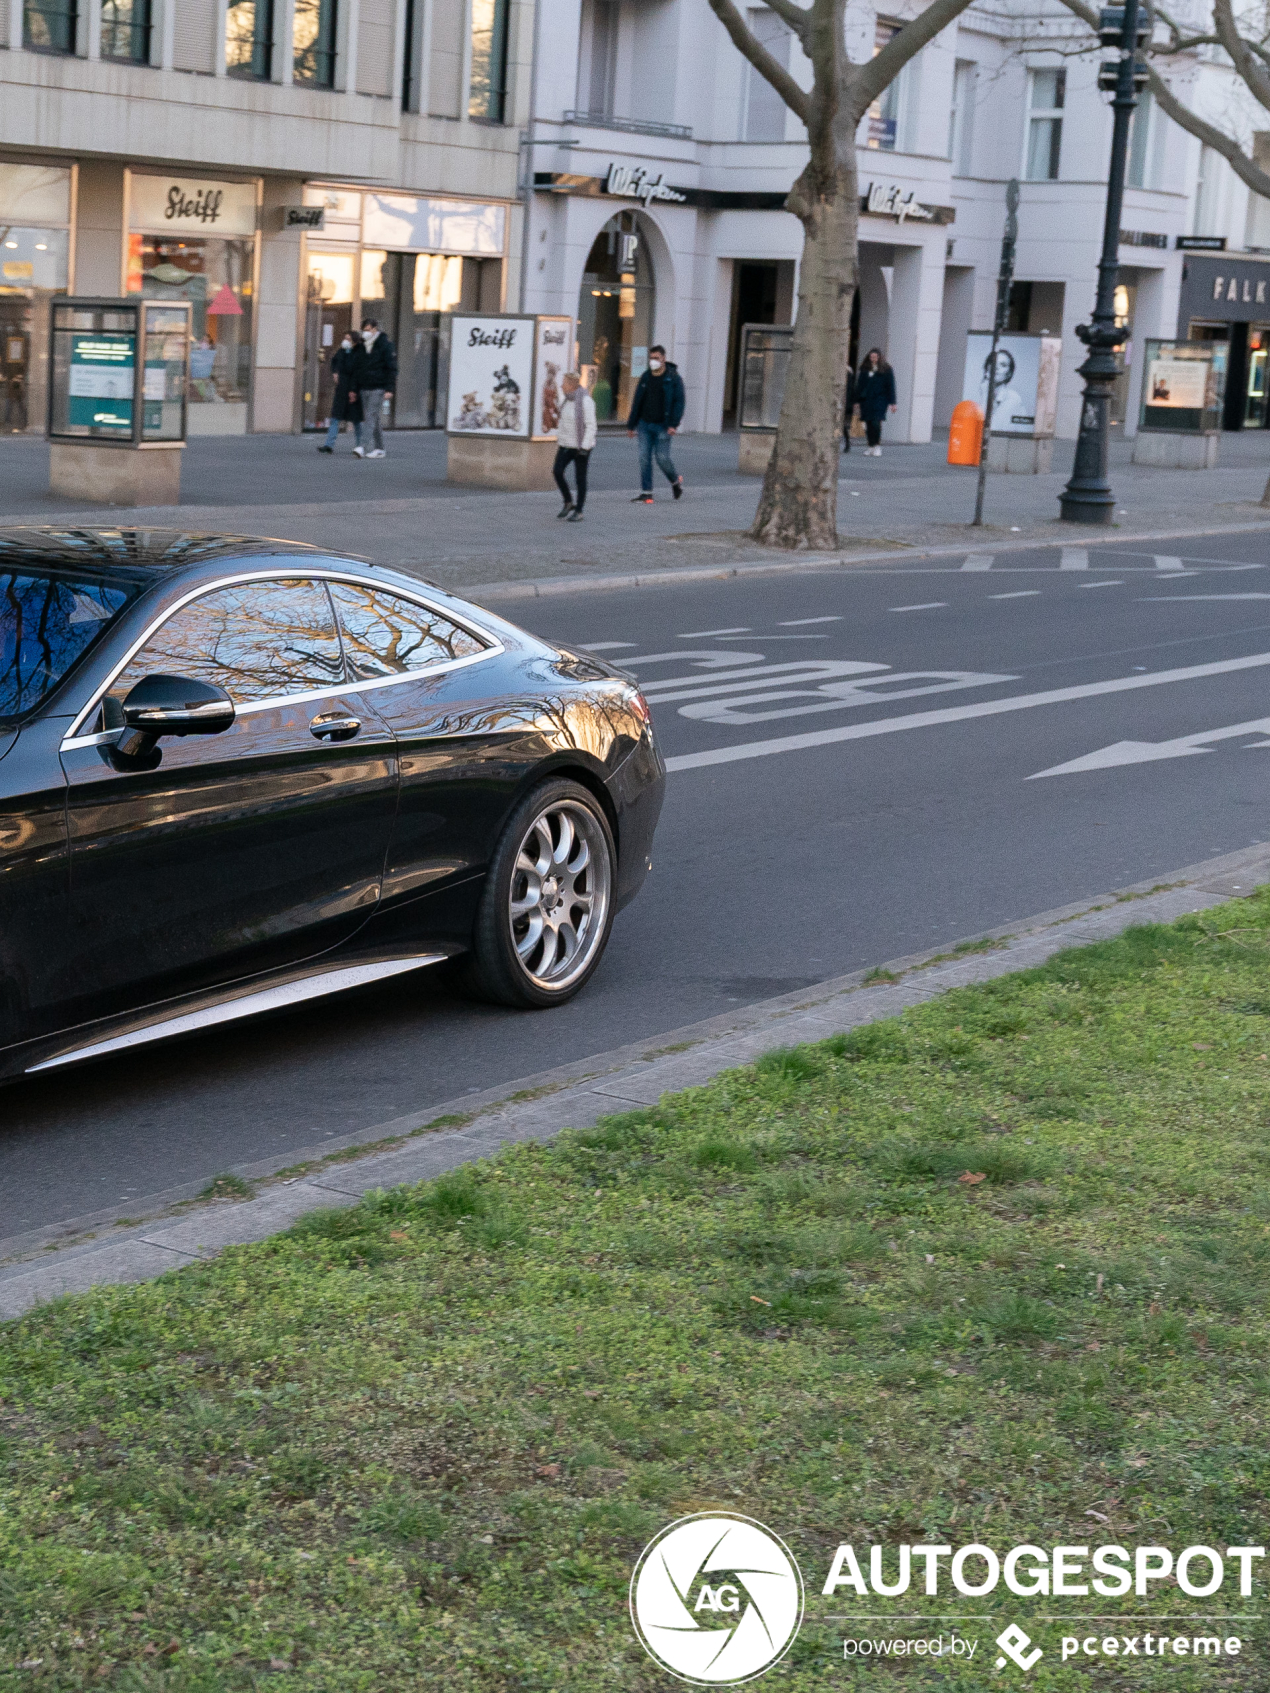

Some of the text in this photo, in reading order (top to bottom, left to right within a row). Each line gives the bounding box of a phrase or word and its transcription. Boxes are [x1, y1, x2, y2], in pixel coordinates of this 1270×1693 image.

[164, 185, 223, 224] Steiff
[1212, 275, 1267, 304] FALK
[467, 327, 517, 349] Steiff
